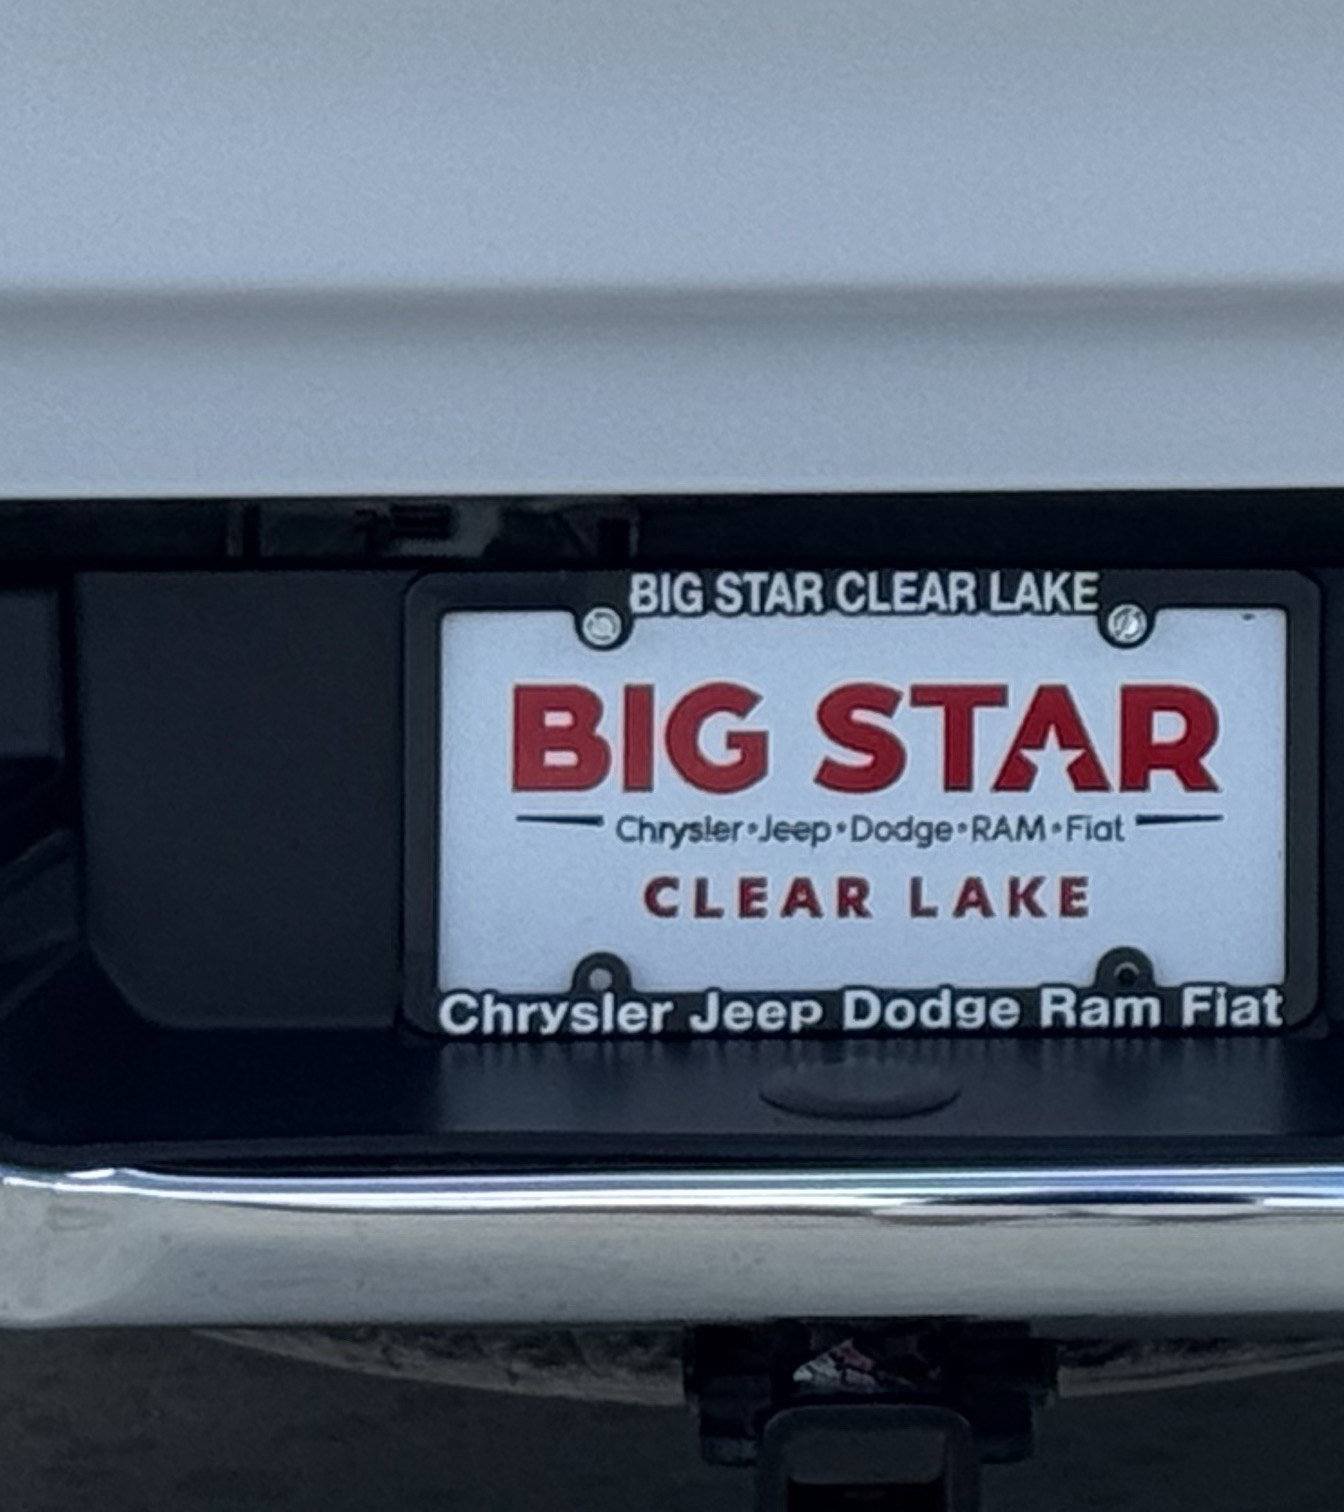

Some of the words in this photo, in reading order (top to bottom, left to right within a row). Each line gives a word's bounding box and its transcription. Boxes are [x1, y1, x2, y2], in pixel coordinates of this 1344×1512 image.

[629, 571, 703, 614] BIG
[715, 571, 824, 614] STAR
[836, 570, 977, 613] CLEAR
[989, 570, 1099, 612] LAKE
[512, 681, 769, 795] BIG
[813, 681, 1222, 795] STAR
[616, 815, 744, 849] Chrysler
[758, 815, 832, 847] Jeep
[851, 815, 954, 848] Dodge
[971, 815, 1047, 842] RAM
[1066, 814, 1126, 842] Fiat
[643, 875, 873, 919] CLEAR
[909, 875, 1090, 919] LAKE
[438, 992, 675, 1035] Chrysler
[689, 990, 823, 1034] Jeep
[842, 989, 1021, 1031] Dodge
[1040, 988, 1161, 1029] Ram
[1181, 986, 1283, 1028] Fiat
